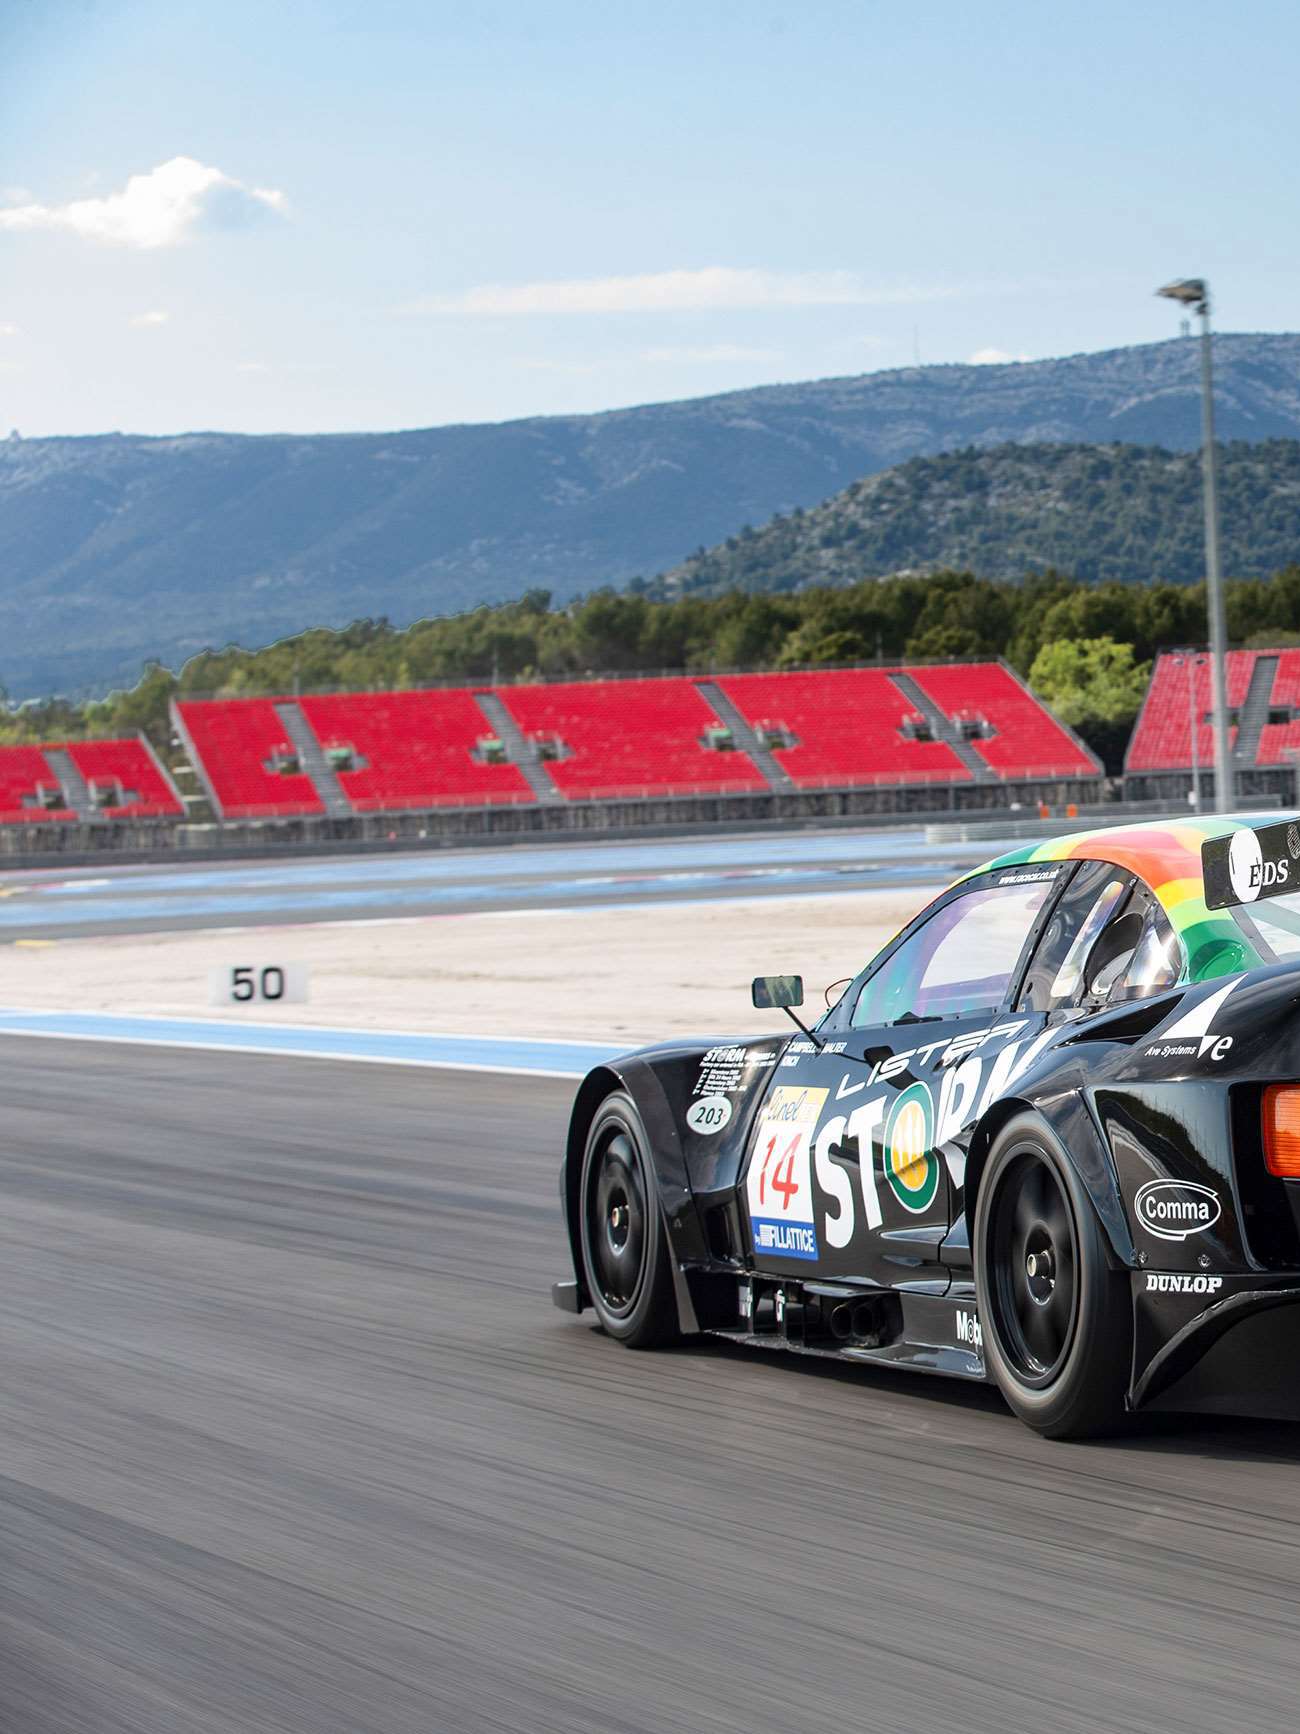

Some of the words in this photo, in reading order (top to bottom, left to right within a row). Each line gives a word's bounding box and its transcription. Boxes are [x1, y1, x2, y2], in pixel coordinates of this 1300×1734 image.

[1248, 859, 1289, 888] EDS
[231, 966, 285, 1001] 50
[703, 1048, 747, 1062] STORM
[836, 1019, 1030, 1100] LISTER
[1161, 1045, 1197, 1058] Systems
[694, 1106, 724, 1125] 203
[760, 1133, 802, 1210] 14
[1145, 1195, 1209, 1220] Comma
[1145, 1274, 1223, 1293] DUNLOP
